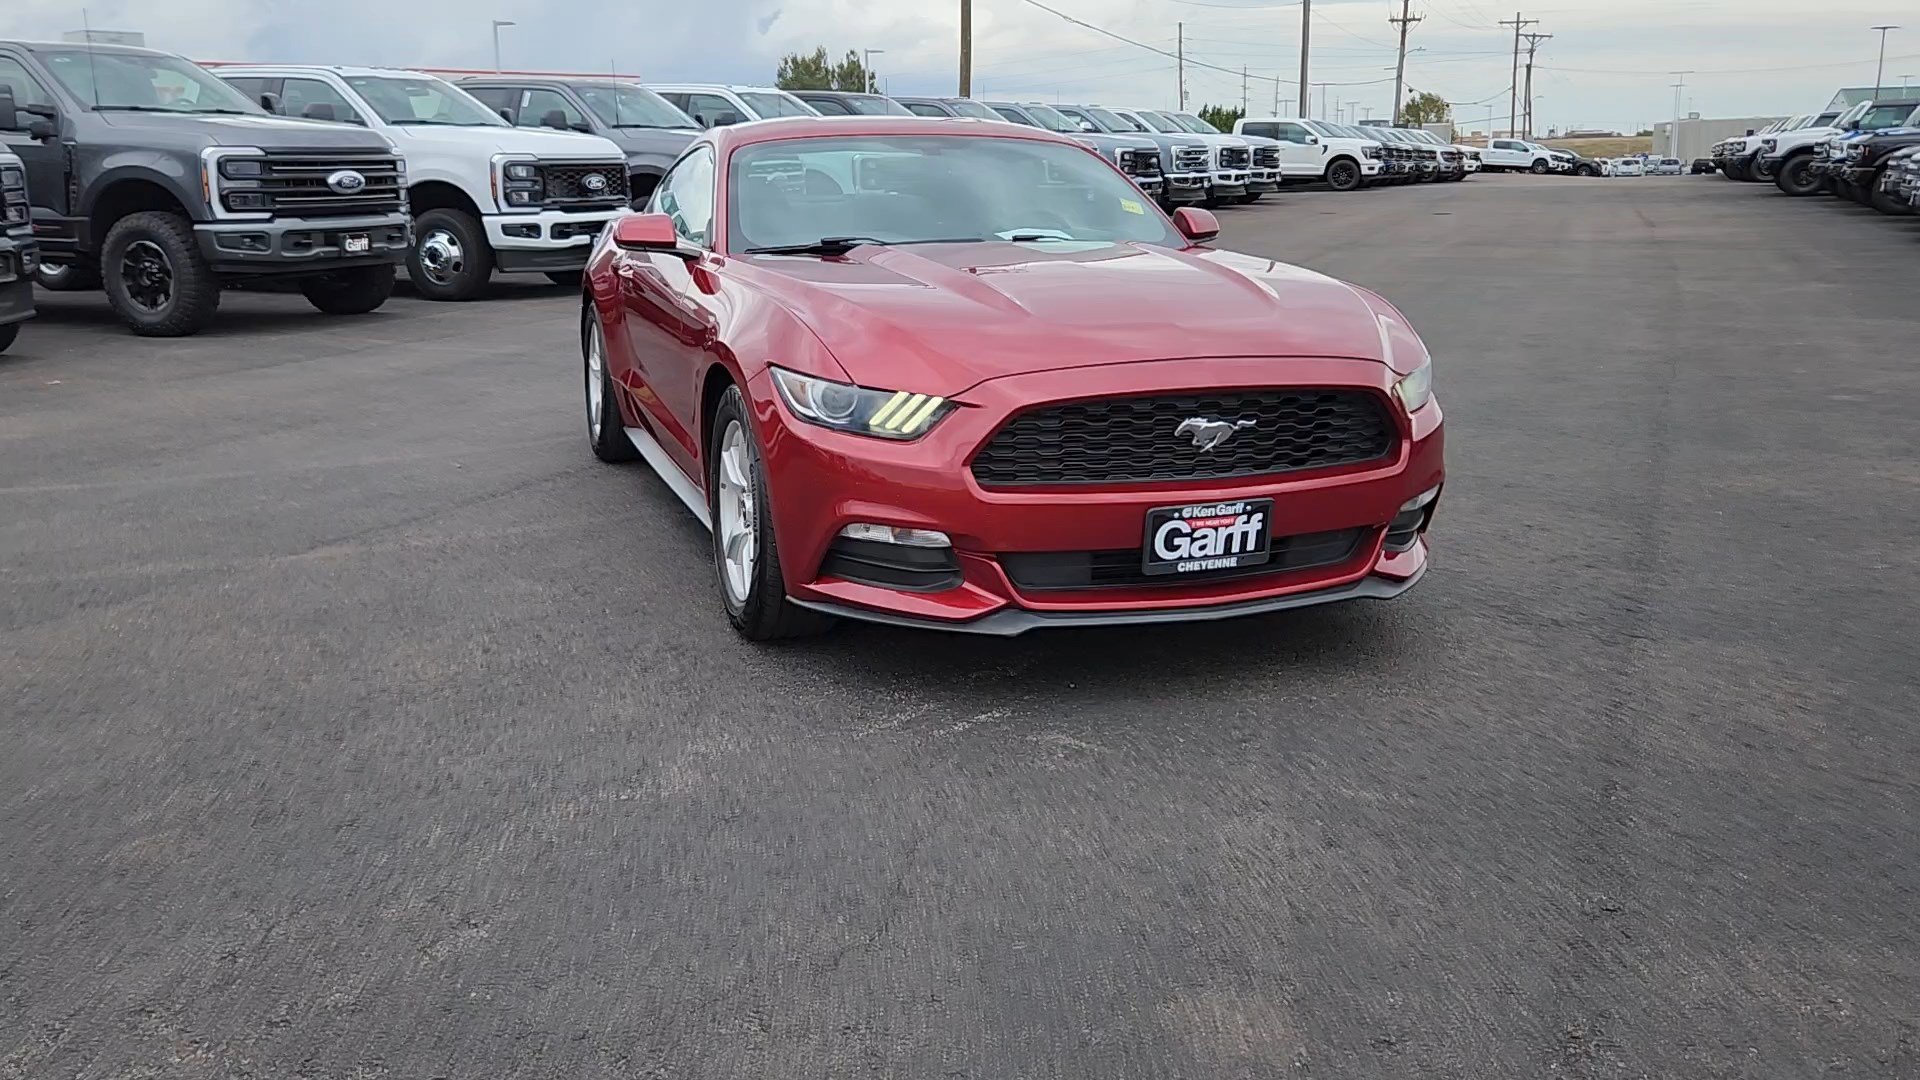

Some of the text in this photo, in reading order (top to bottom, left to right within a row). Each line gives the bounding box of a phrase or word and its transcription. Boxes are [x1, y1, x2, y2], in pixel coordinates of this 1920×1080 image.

[1193, 502, 1244, 517] Ken Garff
[1154, 513, 1264, 560] Garff
[1177, 557, 1238, 572] CHEYENNE
